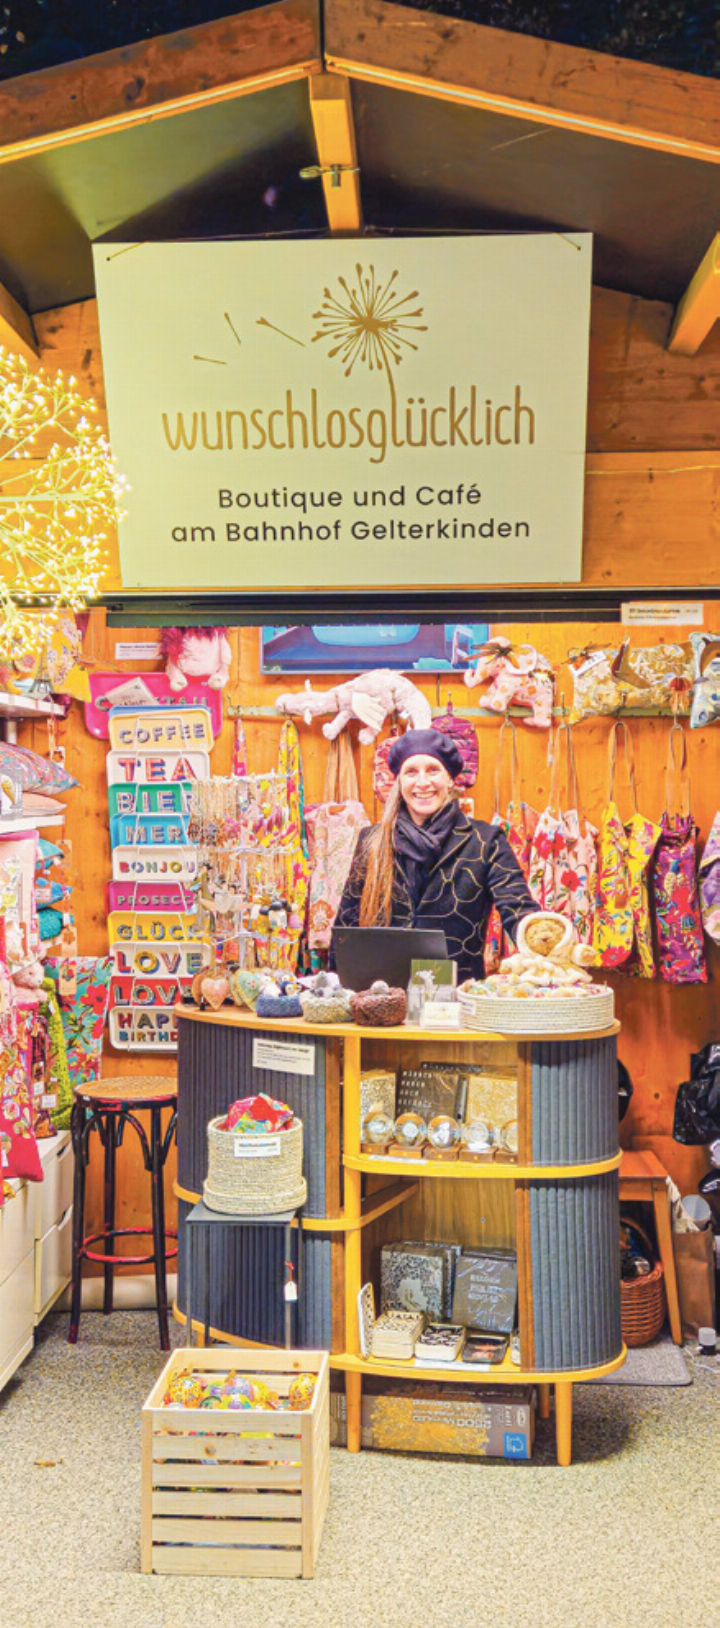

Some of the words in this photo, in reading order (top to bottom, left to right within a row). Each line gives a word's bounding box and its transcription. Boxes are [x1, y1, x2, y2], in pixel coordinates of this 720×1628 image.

[162, 384, 535, 464] wunschlosglücklich
[218, 487, 343, 514] Boutique
[353, 485, 406, 507] und
[415, 483, 482, 506] Café
[171, 526, 216, 543] am
[226, 520, 342, 542] Bahnhof
[351, 517, 531, 540] Gelterkinden
[118, 722, 205, 744] COFFEE
[117, 757, 197, 782] TEA
[116, 791, 197, 813] BIER
[126, 826, 198, 844] MER
[117, 895, 197, 905] PROSECC
[117, 921, 202, 940] GLÜCK
[117, 951, 204, 974] LOVE
